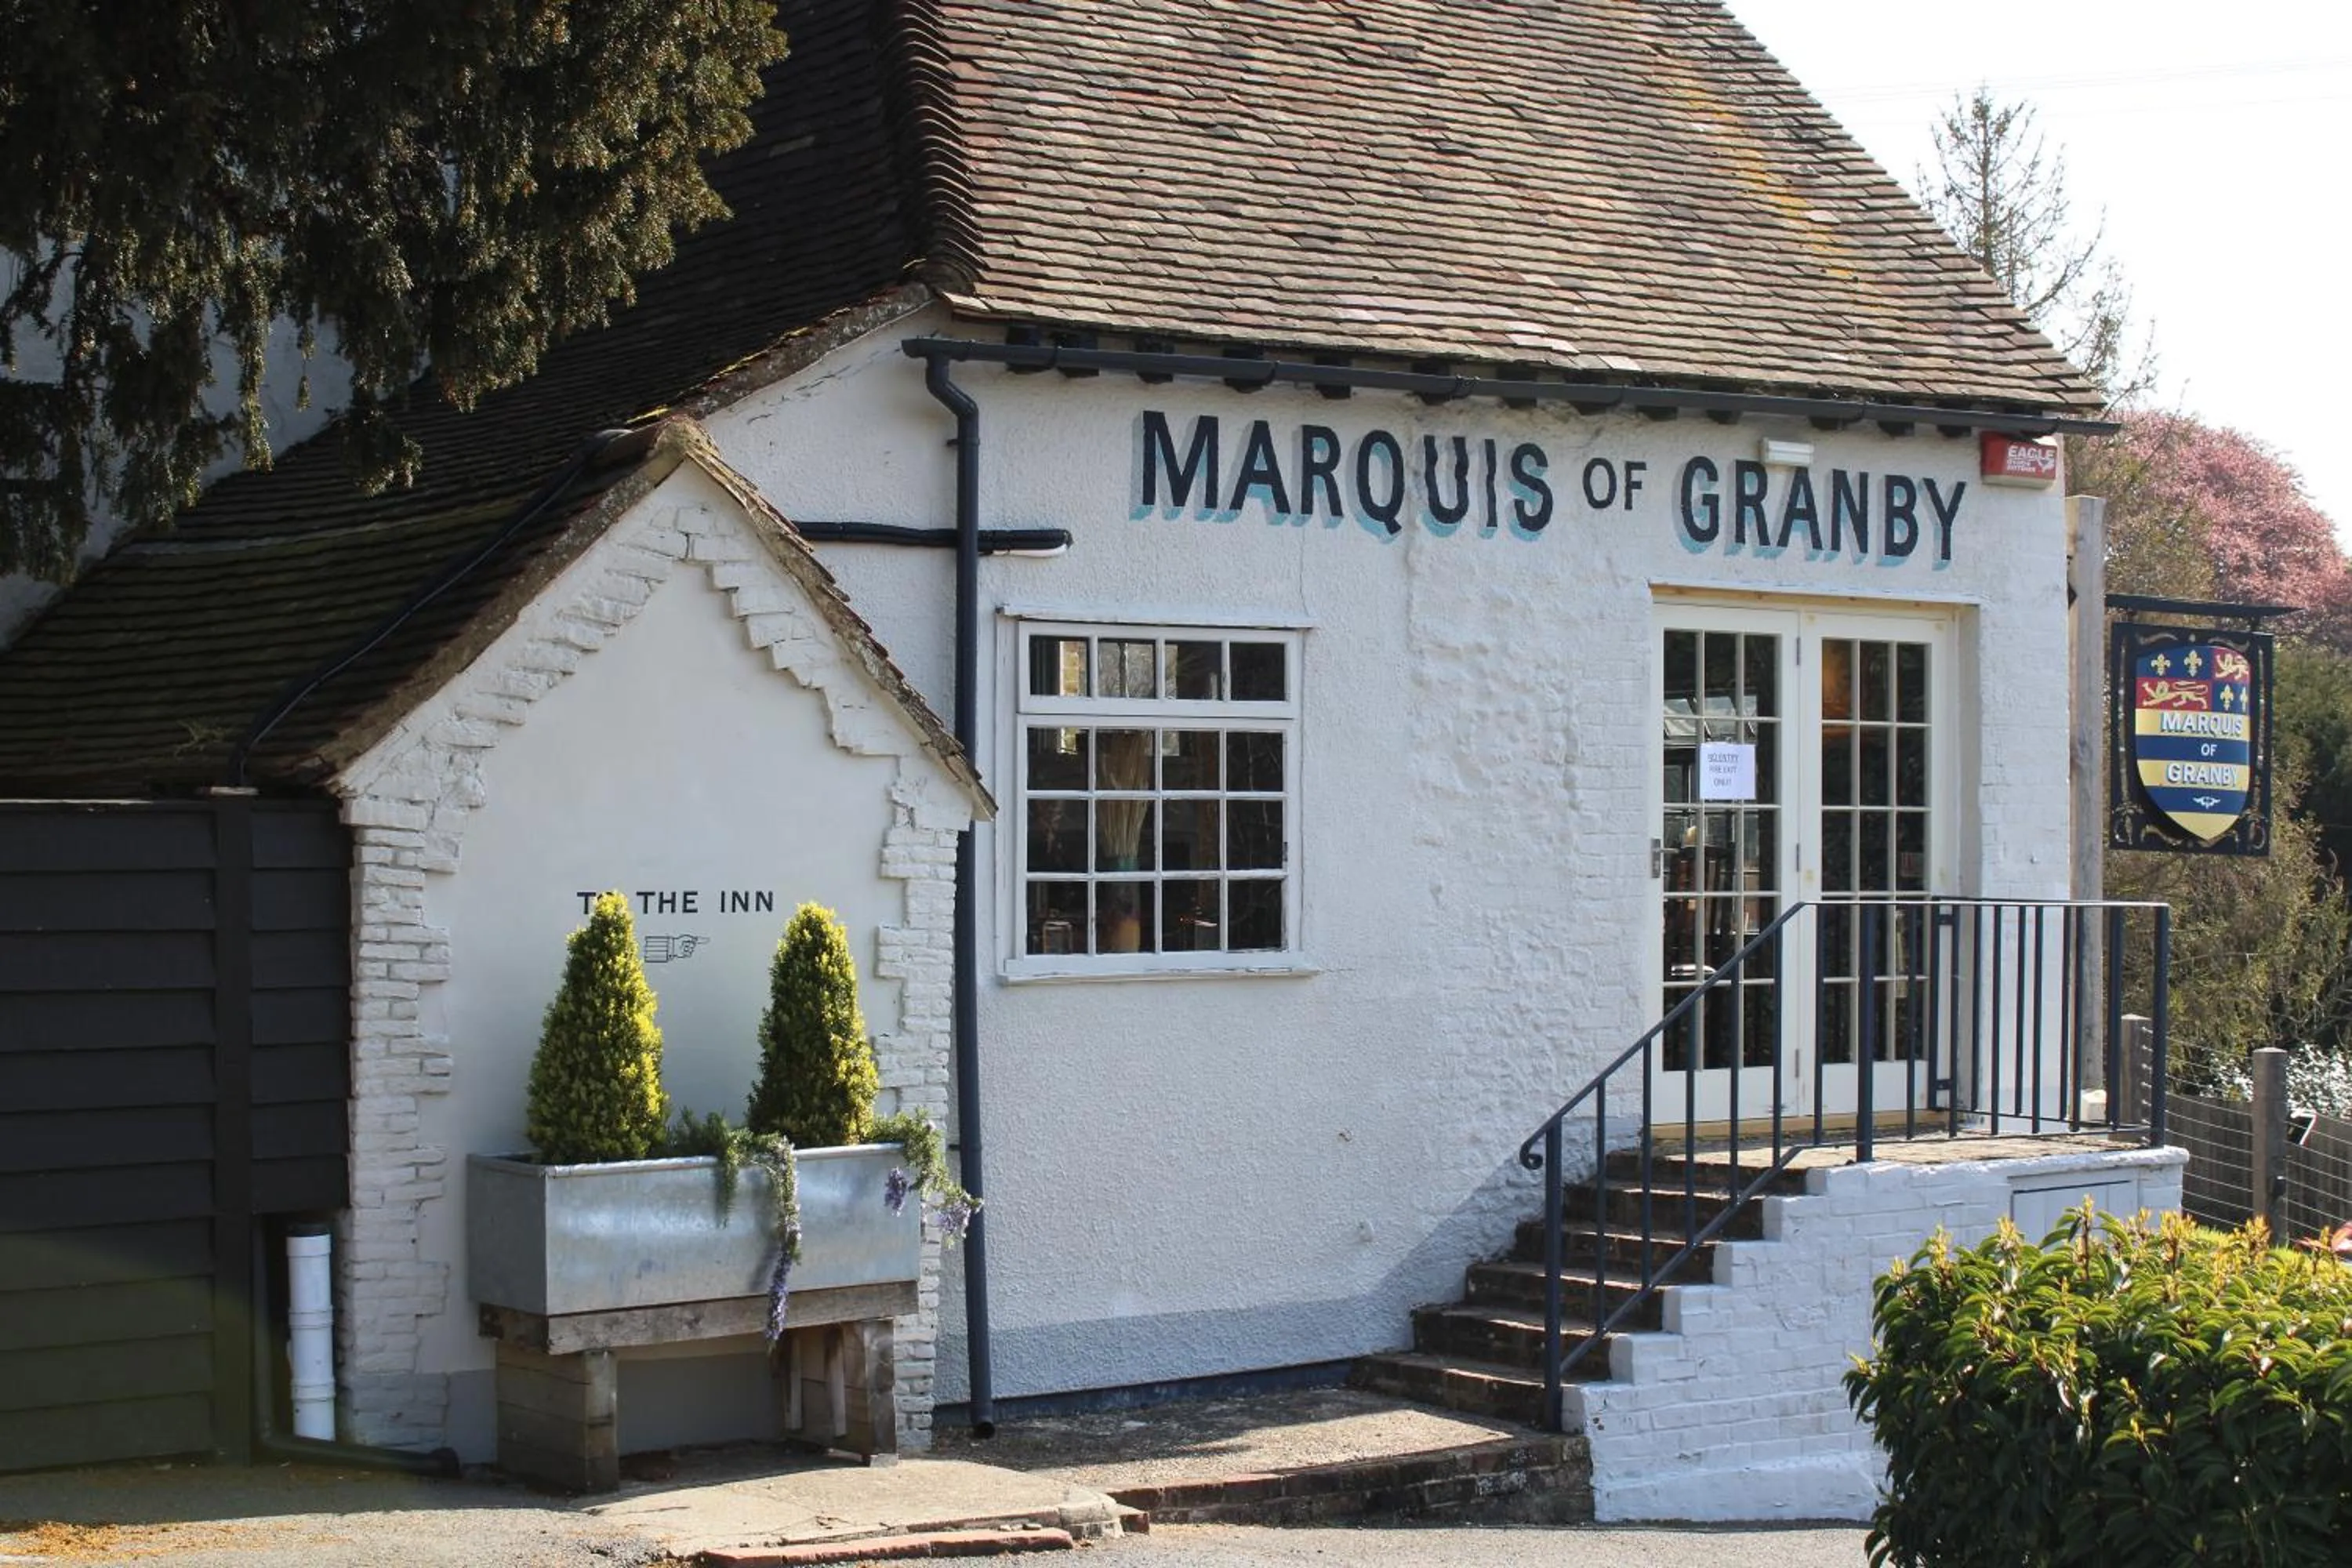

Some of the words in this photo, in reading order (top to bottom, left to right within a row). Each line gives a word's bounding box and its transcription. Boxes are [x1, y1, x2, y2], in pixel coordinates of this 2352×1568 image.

[2008, 445, 2055, 459] EAGLE
[1134, 409, 1553, 541] MARQUIS
[1582, 457, 1646, 510] OF
[1678, 455, 1967, 566] GRANBY
[2161, 711, 2243, 736] MARQUIS
[2201, 742, 2217, 757] OF
[2167, 762, 2237, 786] GRANBY
[576, 891, 616, 915] T
[636, 891, 698, 914] THE
[720, 891, 774, 913] INN
